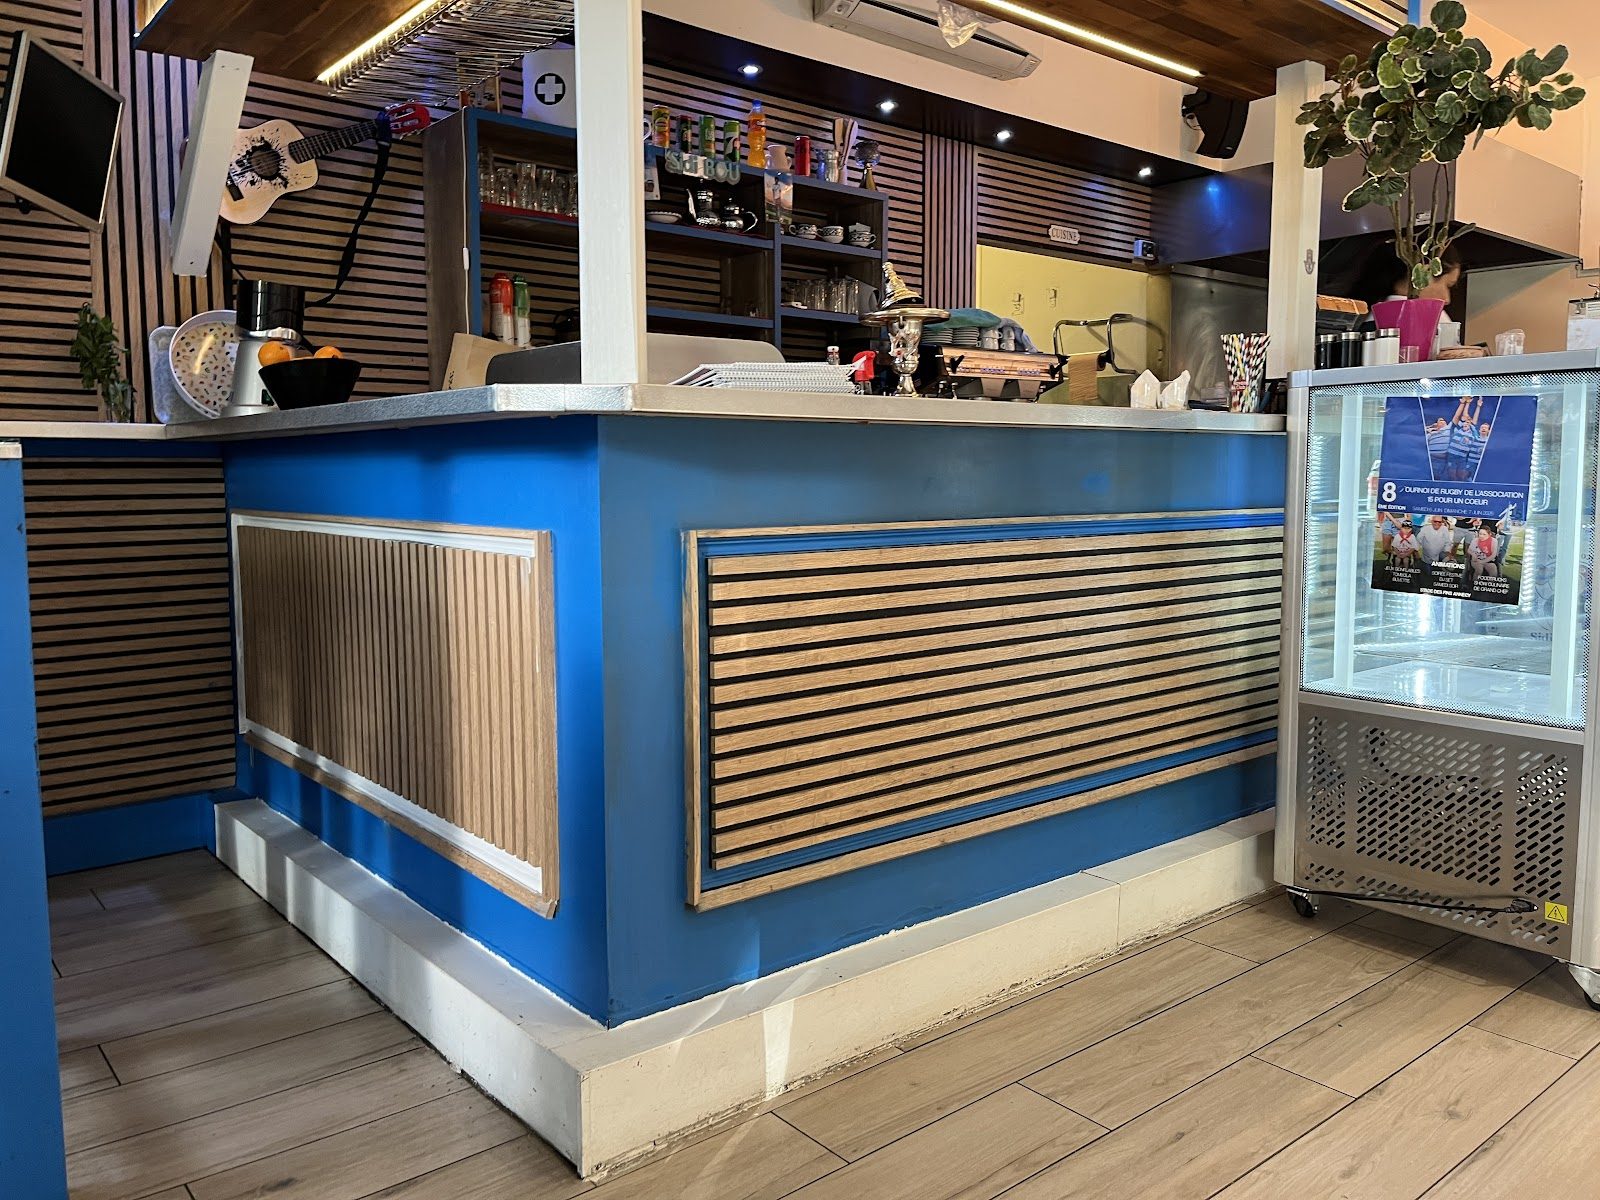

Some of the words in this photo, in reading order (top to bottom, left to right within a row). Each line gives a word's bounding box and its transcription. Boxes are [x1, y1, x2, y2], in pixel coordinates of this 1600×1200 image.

[1051, 227, 1078, 241] CUISINE
[1382, 481, 1397, 503] 8
[1440, 488, 1464, 496] RUGBY
[1464, 489, 1474, 497] DE
[1475, 489, 1524, 499] L'ASSOCIATION
[1464, 498, 1489, 506] COEUR
[1431, 560, 1466, 570] ANIMATIONS
